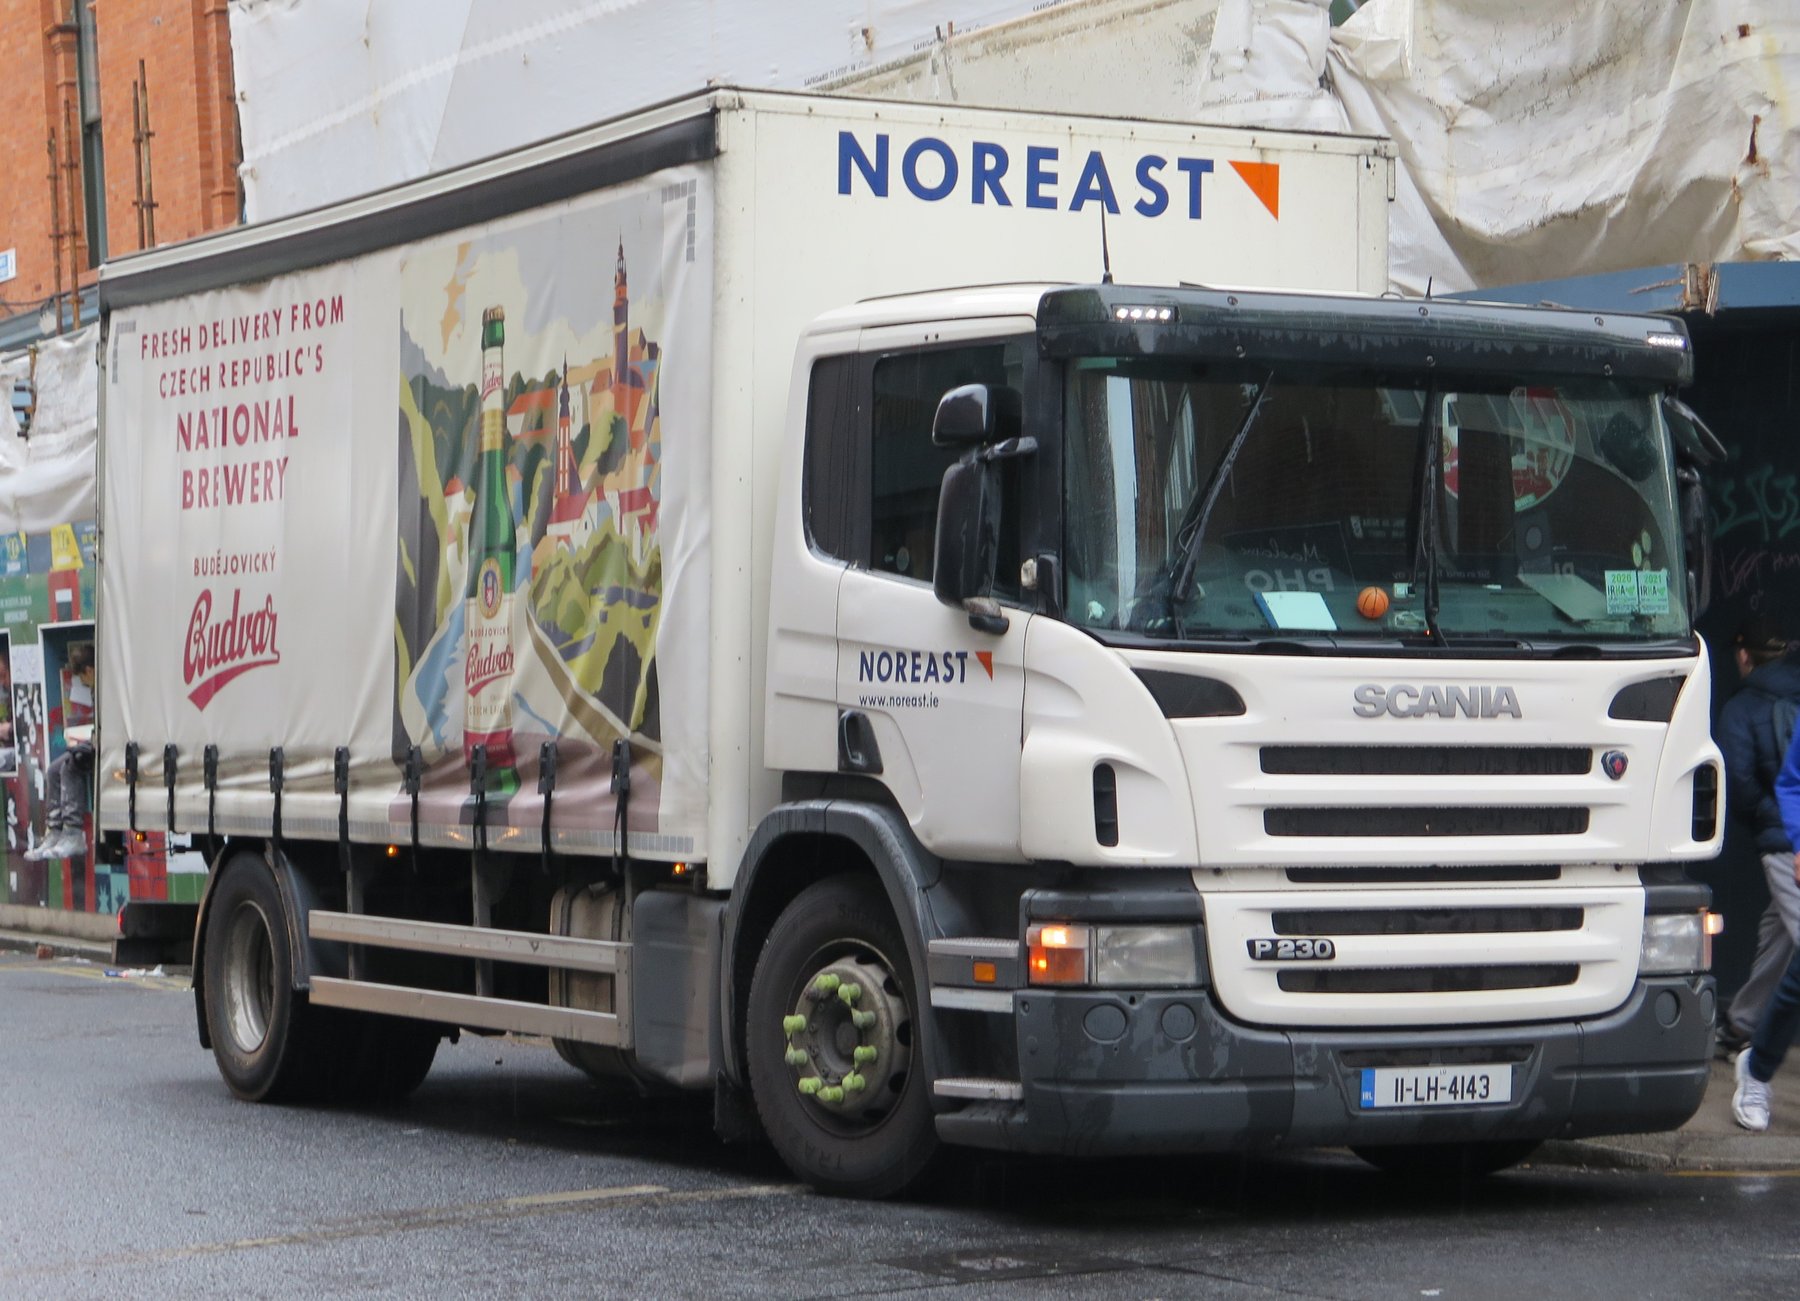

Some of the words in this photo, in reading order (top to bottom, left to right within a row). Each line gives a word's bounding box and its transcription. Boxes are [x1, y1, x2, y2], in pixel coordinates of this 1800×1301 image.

[838, 131, 1214, 220] NOREAST
[141, 327, 191, 360] FRESH
[199, 308, 282, 350] DELIVERY
[291, 294, 344, 332] FROM
[160, 365, 210, 399] CZECH
[219, 344, 323, 389] REPUBLIC'S
[176, 395, 299, 452] NATIONAL
[182, 457, 289, 510] BREWERY
[183, 588, 281, 686] Budvar
[465, 642, 515, 687] Budvar
[859, 651, 968, 683] NOREAST
[859, 691, 939, 708] www.noreast.ie
[1353, 684, 1523, 719] SCANIA
[1255, 940, 1273, 959] P
[1277, 940, 1332, 959] 230
[1362, 1090, 1373, 1100] IRL
[1394, 1075, 1490, 1103] 11-LH-4143
